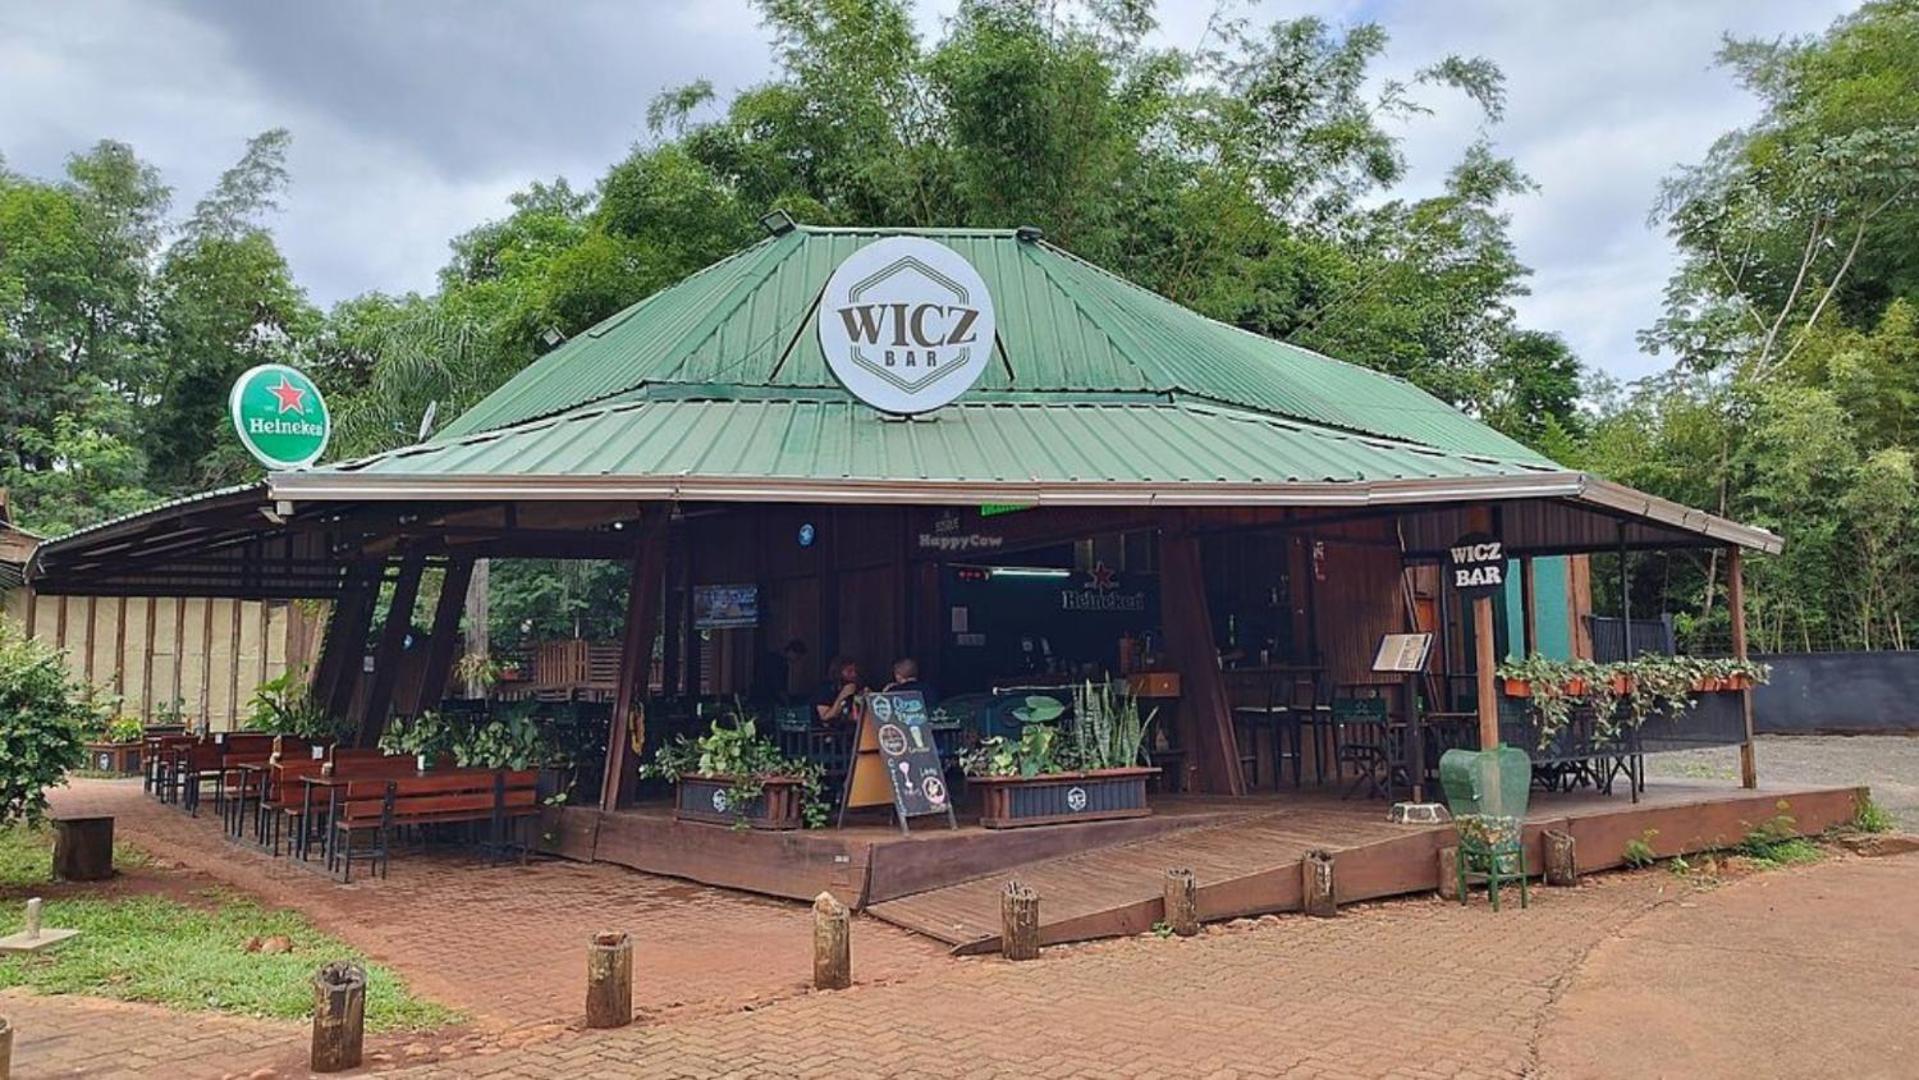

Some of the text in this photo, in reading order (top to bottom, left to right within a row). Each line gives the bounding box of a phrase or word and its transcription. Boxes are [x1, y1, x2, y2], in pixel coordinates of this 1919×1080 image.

[837, 303, 980, 348] WICZ
[885, 351, 937, 367] BAR
[250, 418, 323, 437] Heineken
[919, 534, 1003, 550] HappyCow
[1451, 542, 1502, 564] WICZ
[1455, 566, 1502, 587] BAR
